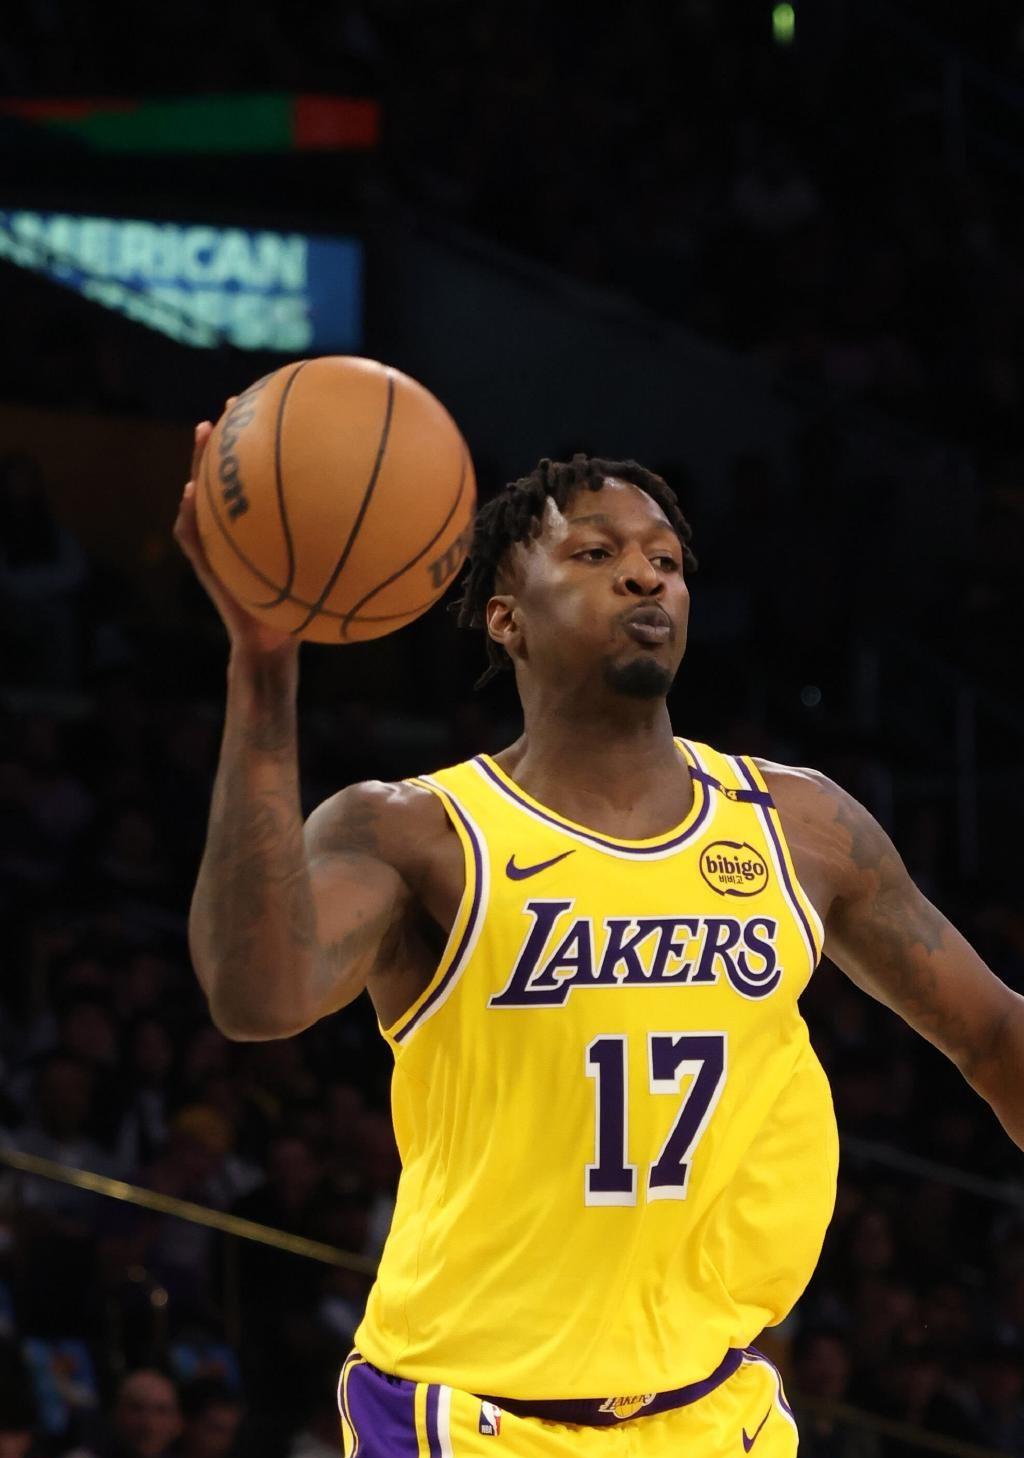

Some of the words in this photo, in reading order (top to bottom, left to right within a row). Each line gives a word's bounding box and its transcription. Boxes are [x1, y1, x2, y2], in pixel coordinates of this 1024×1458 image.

[0, 213, 307, 289] MERICAN
[706, 855, 764, 880] bibigo
[718, 875, 744, 884] 비비고
[488, 899, 782, 1007] LAKERS
[585, 1032, 728, 1206] 17
